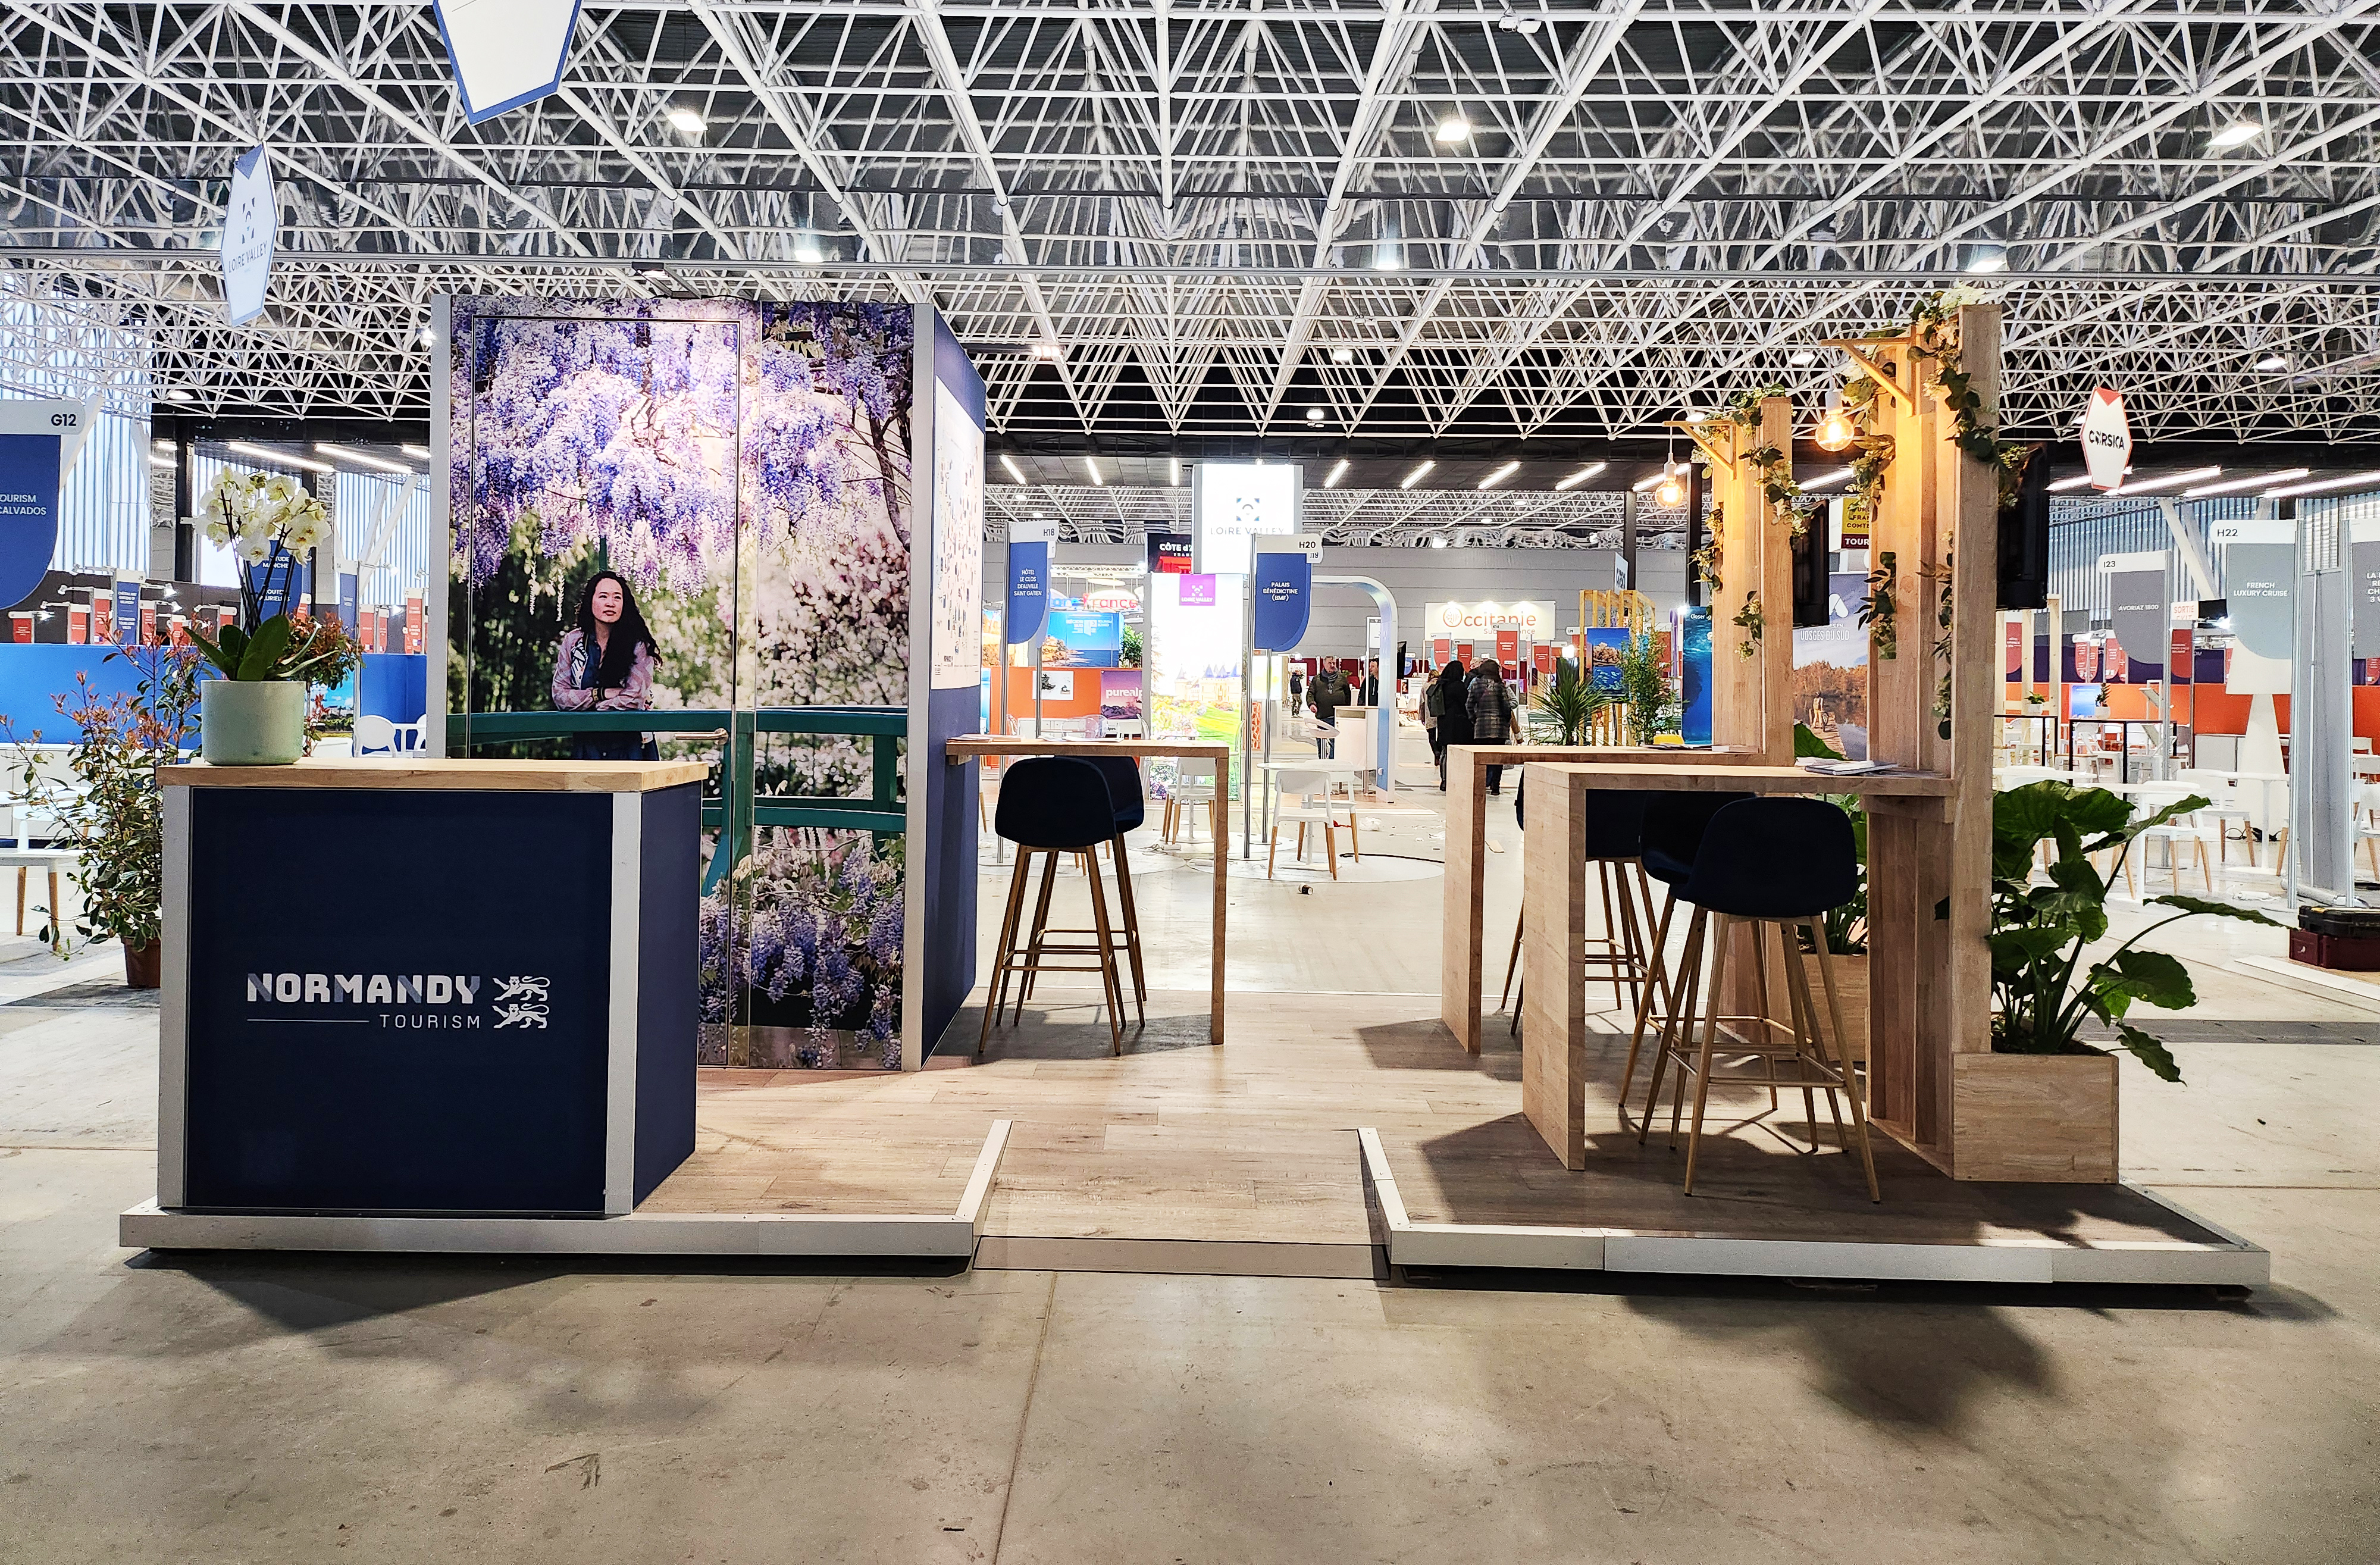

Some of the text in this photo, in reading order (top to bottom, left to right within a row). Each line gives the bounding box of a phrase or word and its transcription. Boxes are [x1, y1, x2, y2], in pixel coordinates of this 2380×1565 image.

[246, 240, 267, 263] VALLEY
[51, 414, 76, 426] G12
[1160, 542, 1181, 551] CÔTE
[2174, 605, 2194, 614] SORTIE
[1826, 630, 1834, 640] DU
[1837, 630, 1849, 640] SUD
[247, 973, 480, 1004] NORMANDY
[380, 1014, 480, 1029] TOURISM
